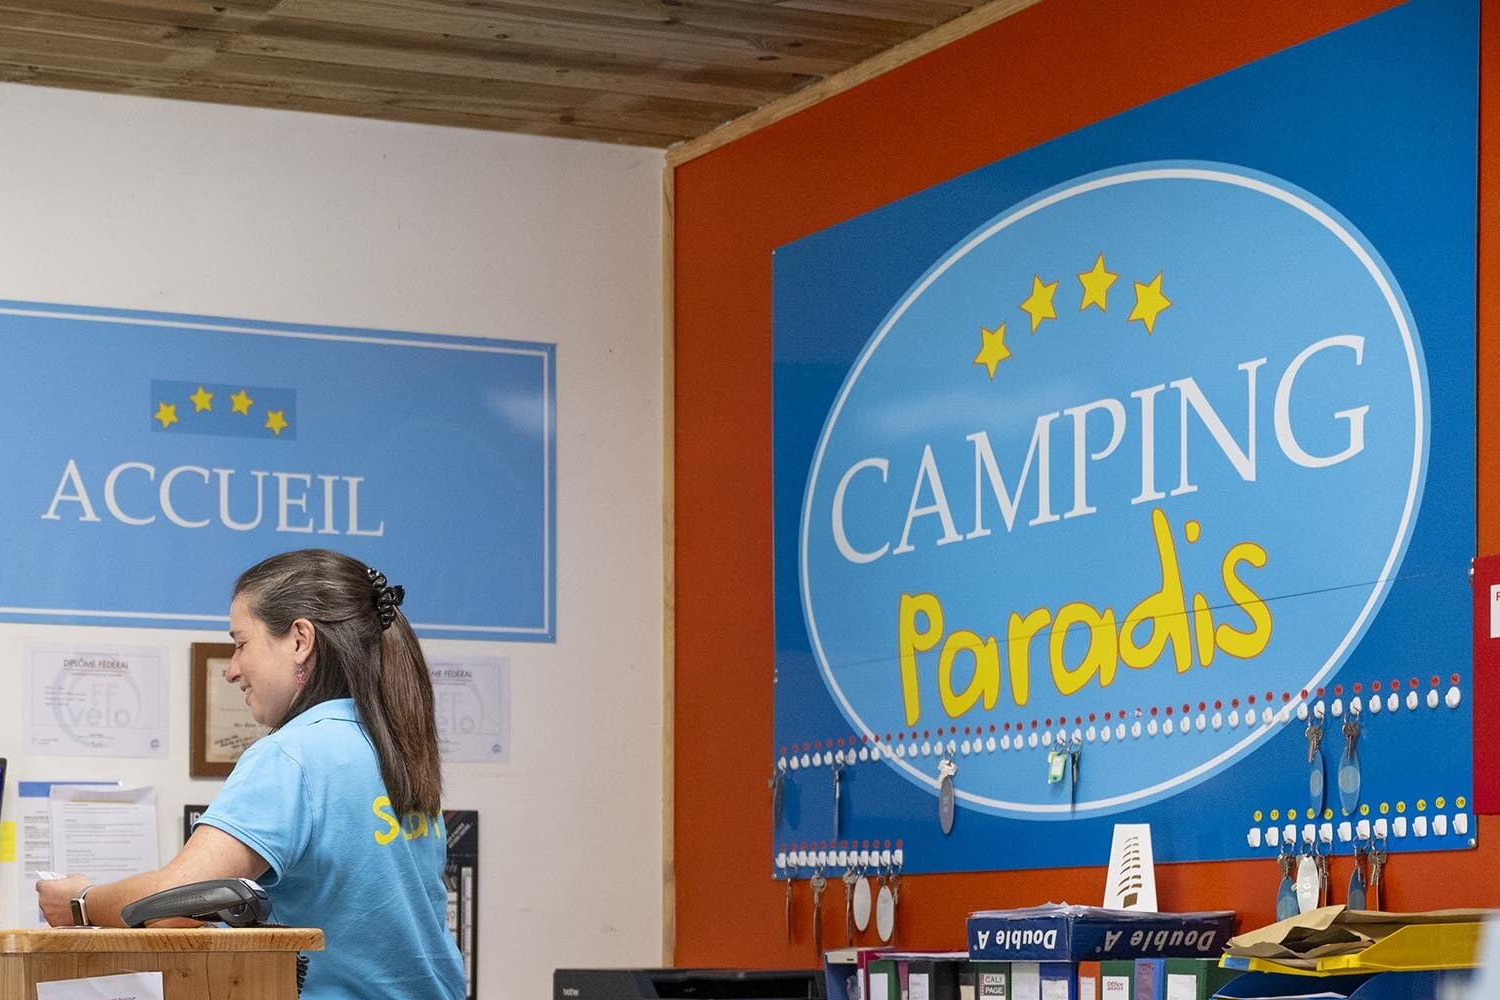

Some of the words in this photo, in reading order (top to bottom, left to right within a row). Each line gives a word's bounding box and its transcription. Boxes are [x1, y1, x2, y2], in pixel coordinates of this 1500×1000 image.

[831, 335, 1370, 564] CAMPING
[41, 459, 385, 536] ACCUEIL
[899, 508, 1273, 727] Paradis
[977, 931, 989, 948] A
[996, 929, 1057, 950] Double
[1105, 930, 1123, 952] A
[1130, 929, 1217, 952] Double
[985, 986, 1004, 995] PAGE
